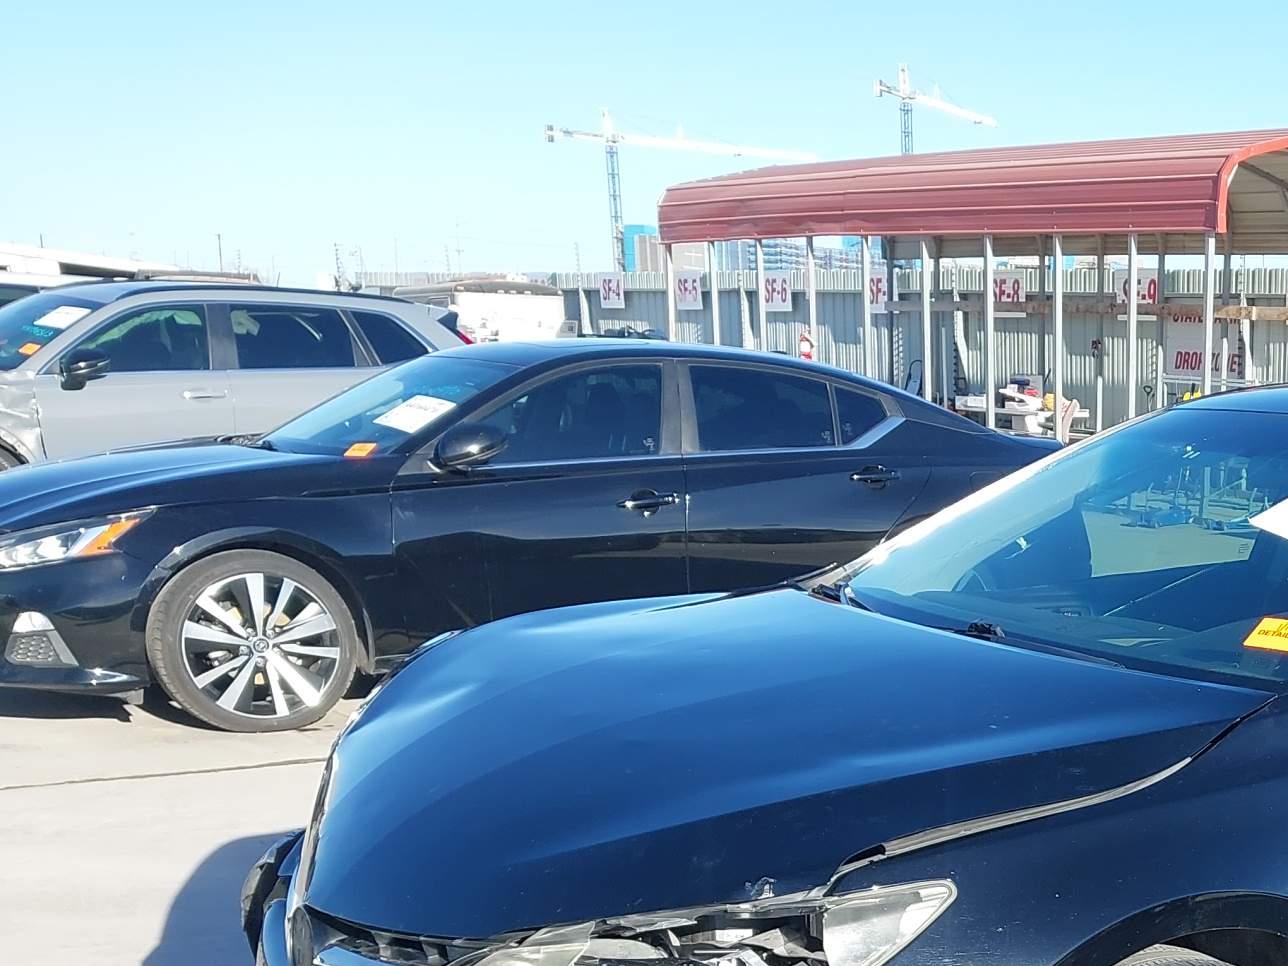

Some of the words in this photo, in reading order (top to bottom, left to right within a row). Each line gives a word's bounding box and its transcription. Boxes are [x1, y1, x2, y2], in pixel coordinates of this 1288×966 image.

[602, 278, 621, 301] SF-4
[677, 278, 698, 302] SF-5
[764, 278, 788, 303] SF-6
[869, 277, 888, 305] SF-
